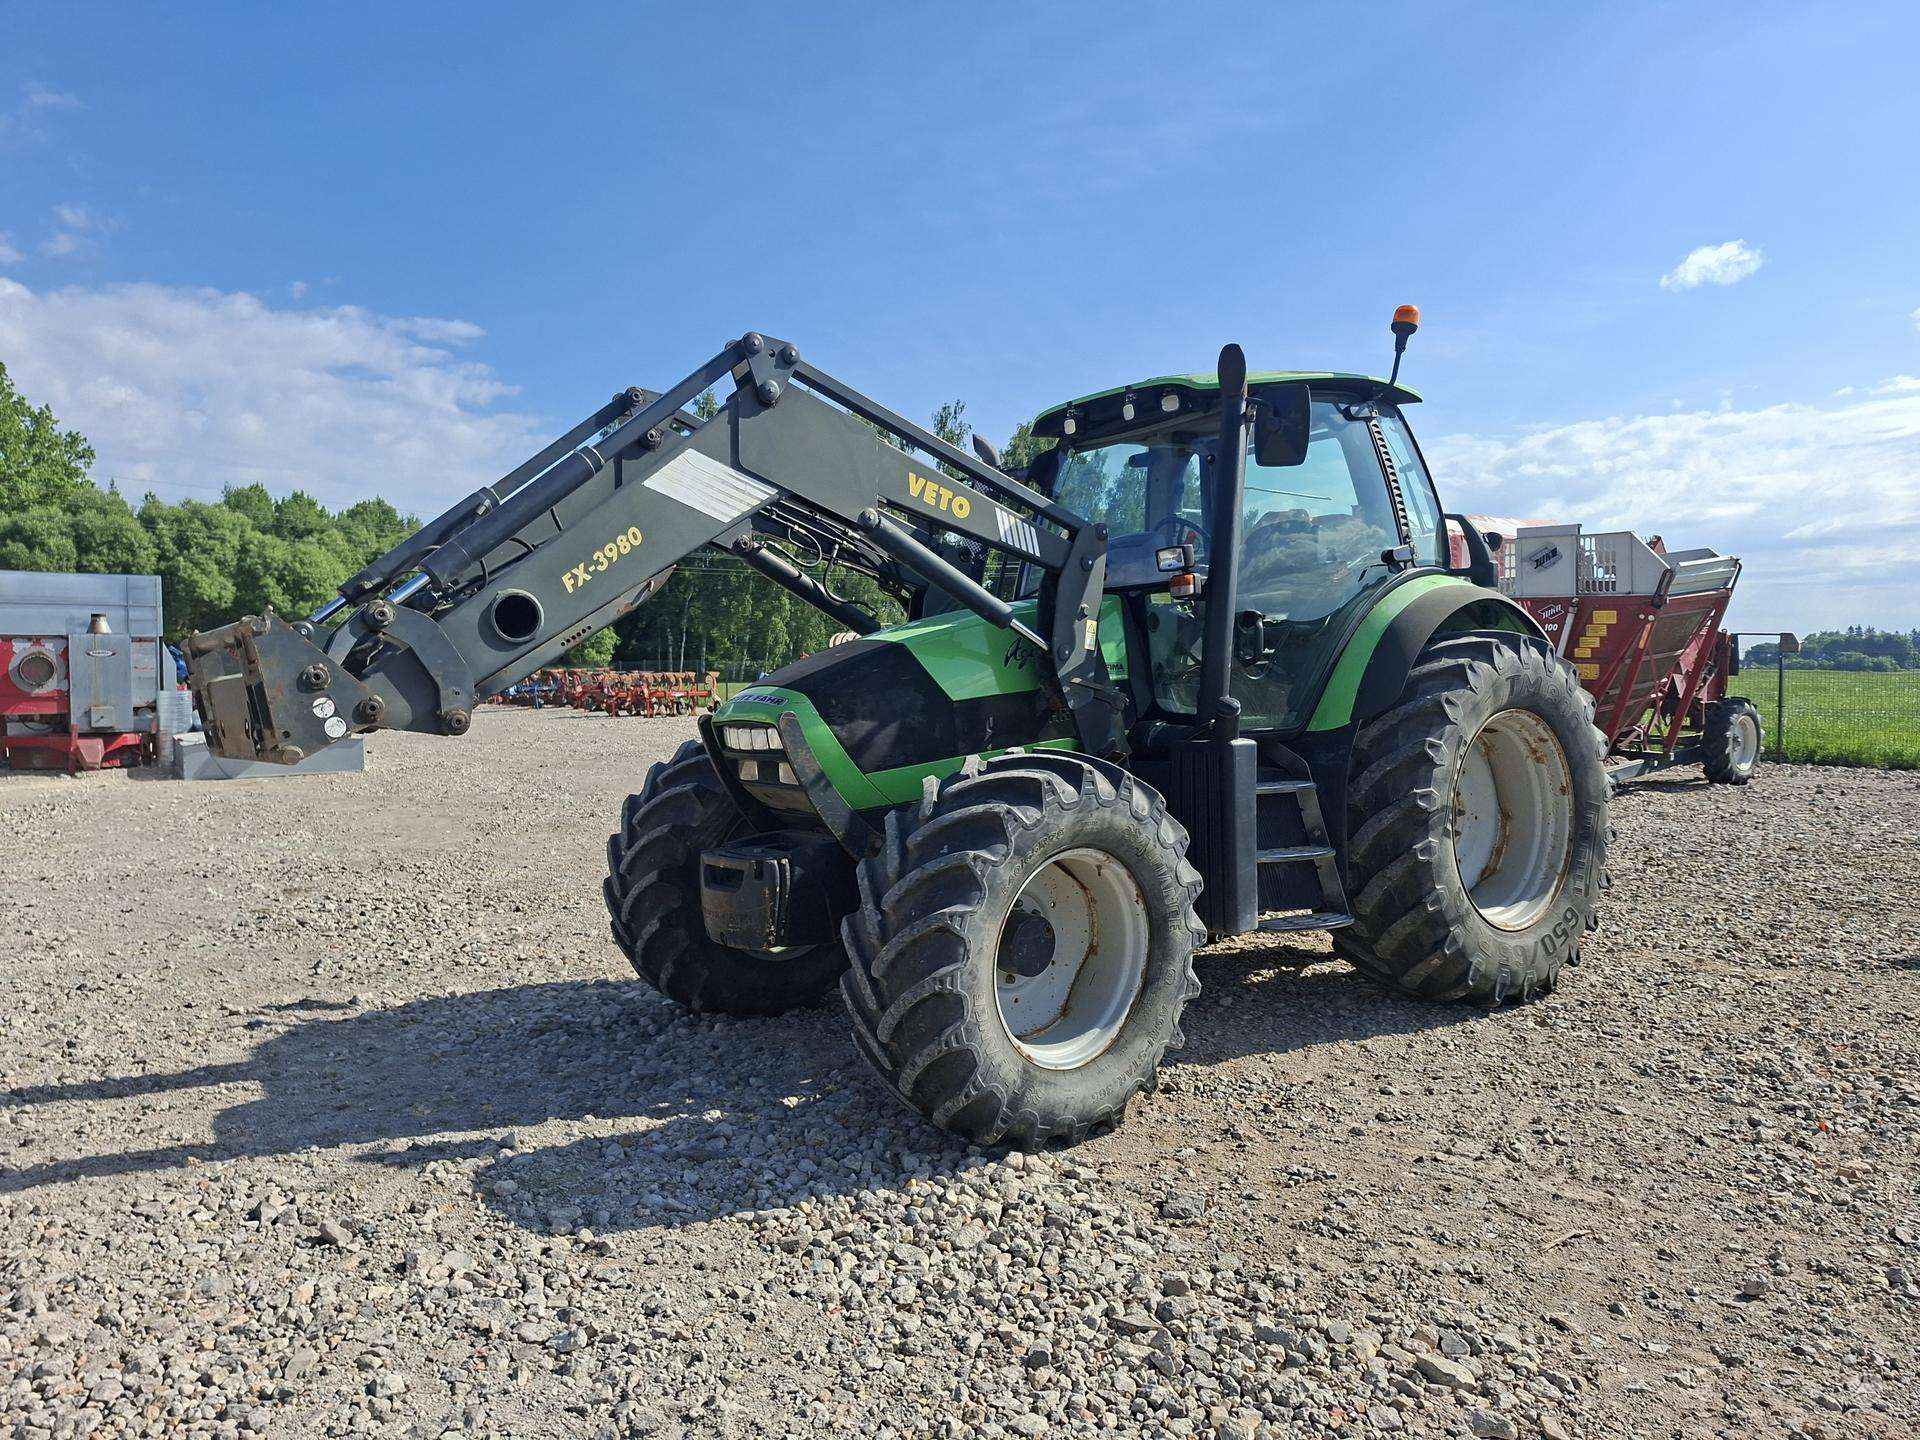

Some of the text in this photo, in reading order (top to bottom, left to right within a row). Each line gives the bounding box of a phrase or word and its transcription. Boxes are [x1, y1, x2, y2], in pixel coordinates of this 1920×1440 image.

[907, 473, 971, 519] VETO
[560, 526, 644, 594] FX-3980
[1544, 623, 1558, 632] 100
